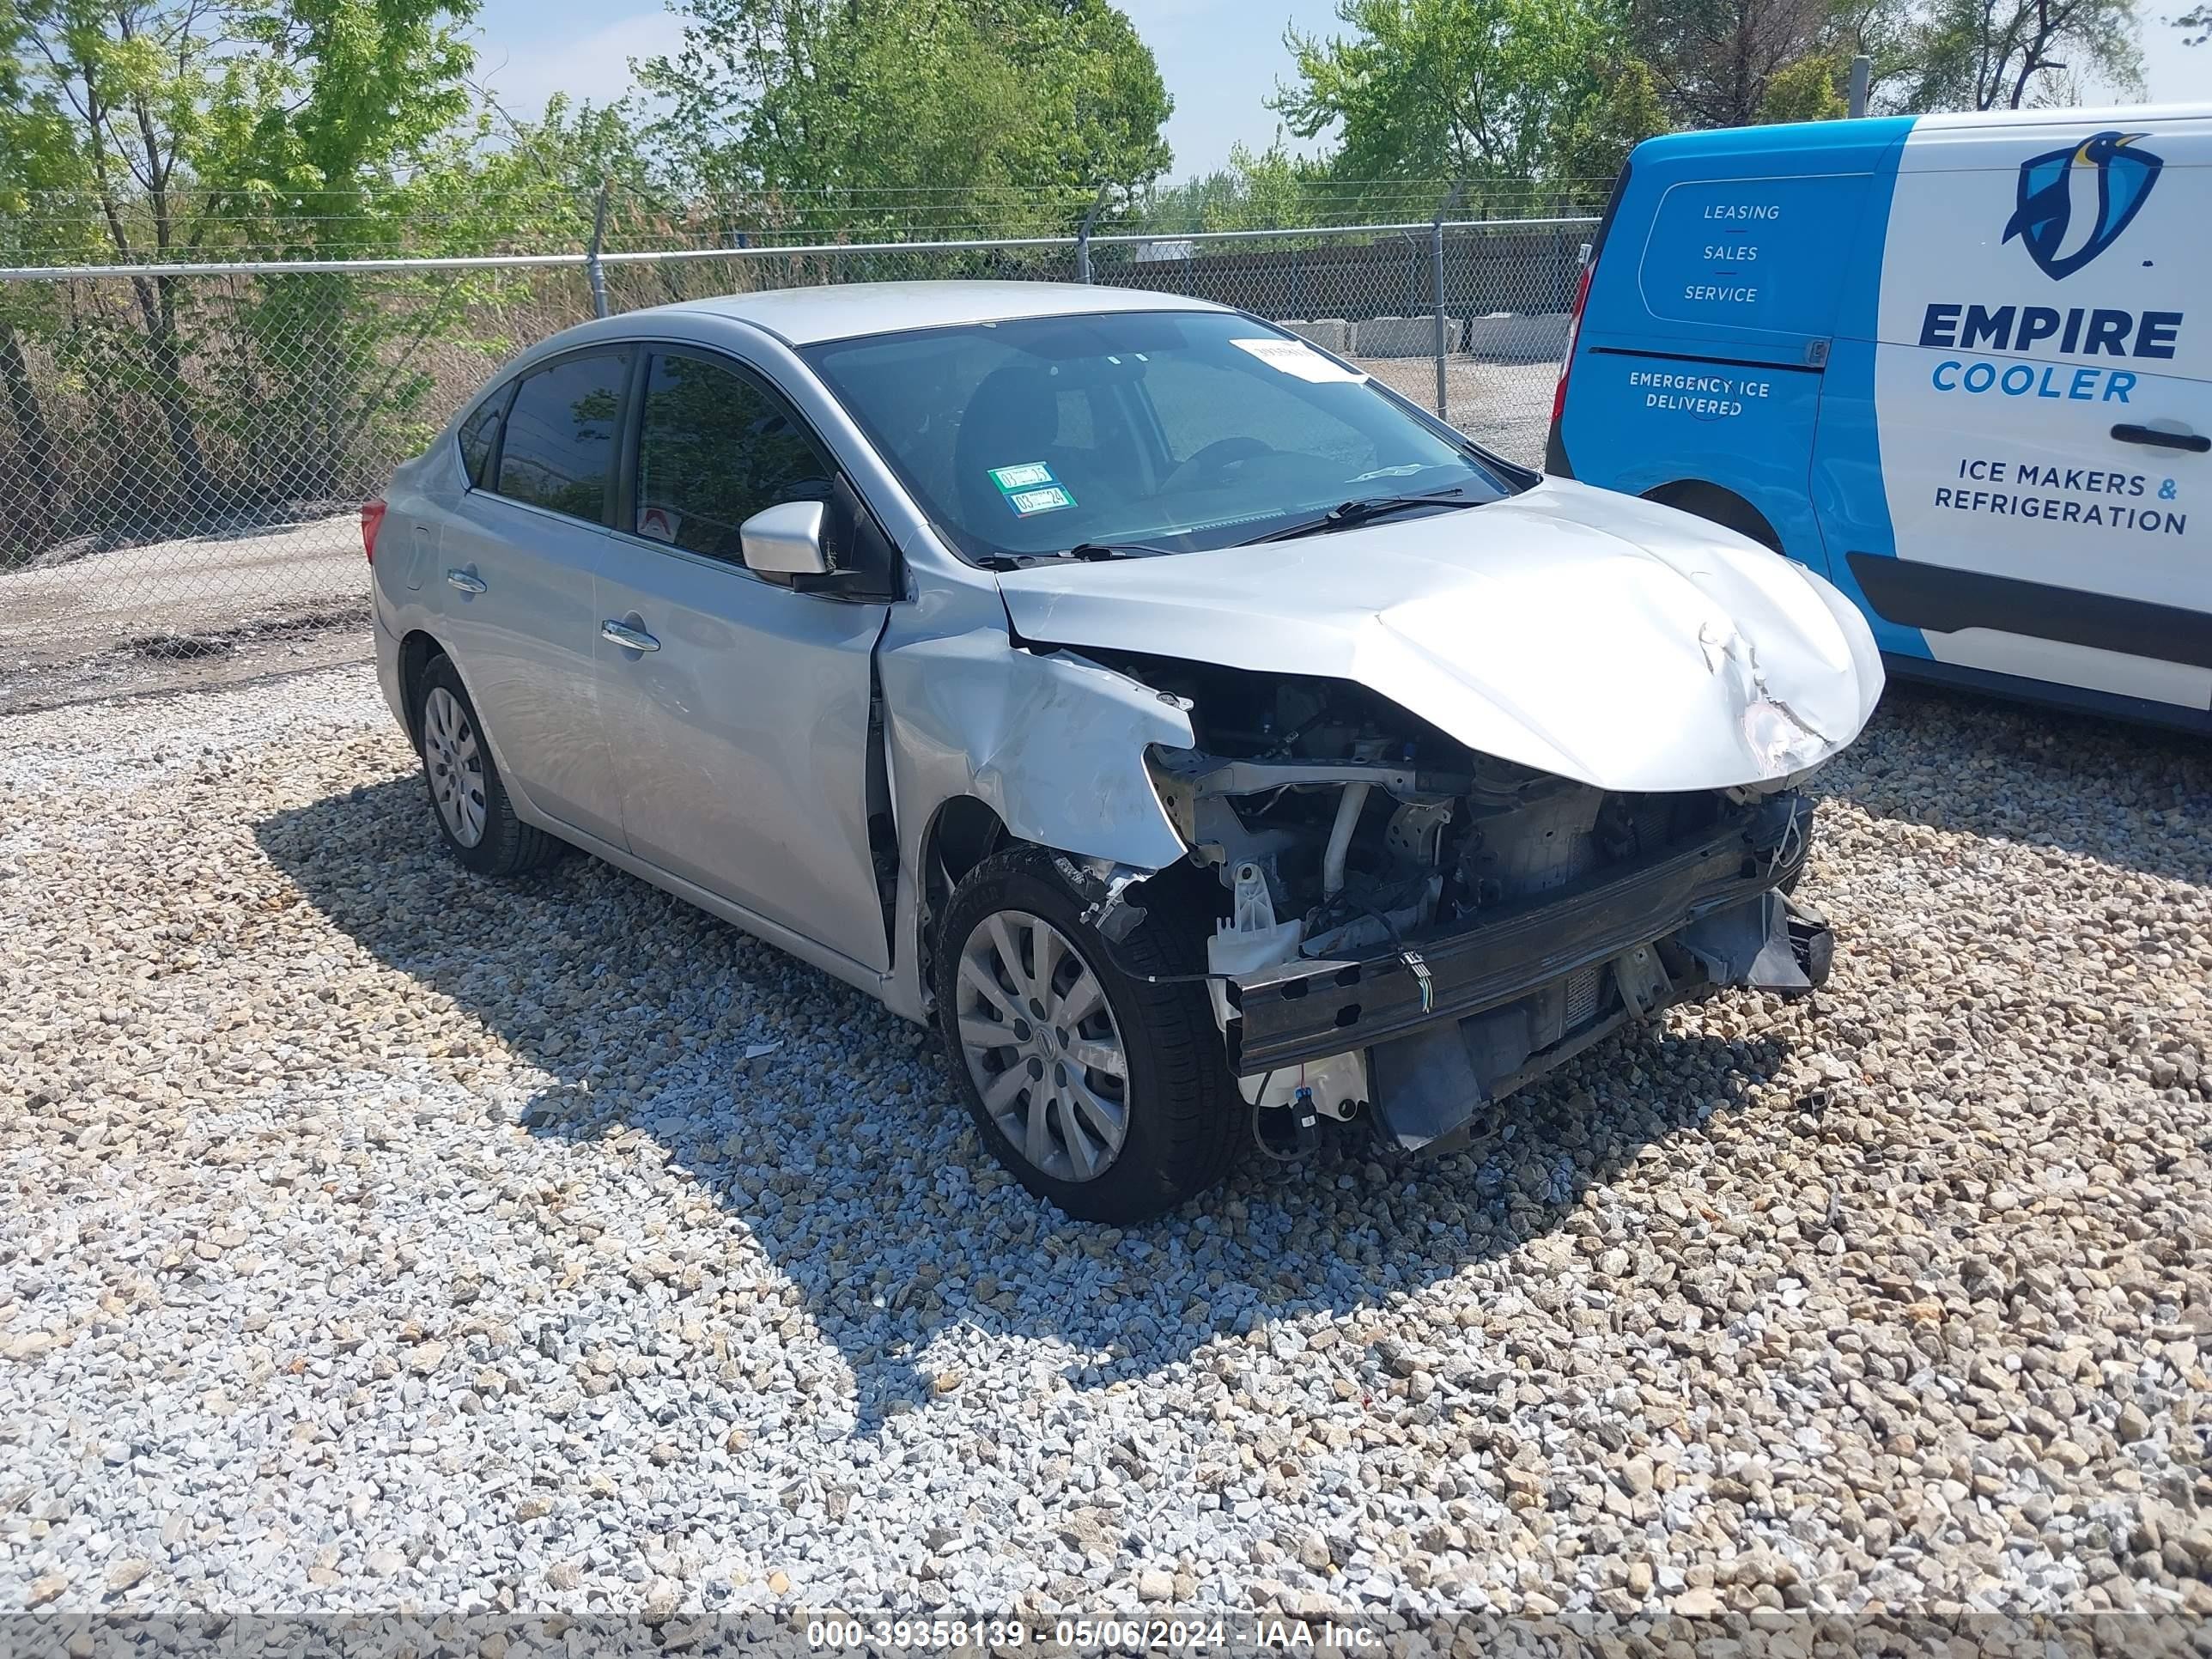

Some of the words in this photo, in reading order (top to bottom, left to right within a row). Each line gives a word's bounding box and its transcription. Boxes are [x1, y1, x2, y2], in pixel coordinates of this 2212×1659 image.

[1705, 205, 1779, 219] LEASING
[1704, 246, 1758, 260] SALES
[1685, 286, 1757, 302] SERVICE
[1918, 303, 2184, 361] EMPIRE
[1630, 372, 1732, 393] EMERGENCY
[1740, 382, 1770, 398] ICE
[1932, 361, 2137, 404] COOLER
[1646, 394, 1742, 416] DELIVERED
[1001, 472, 1018, 487] 03
[1959, 459, 2007, 482] ICE
[2017, 465, 2147, 496] MAKERS
[2156, 477, 2178, 500] &
[1016, 495, 1034, 510] 03
[1047, 489, 1065, 504] 24
[1935, 487, 2187, 536] REFRIGERATION
